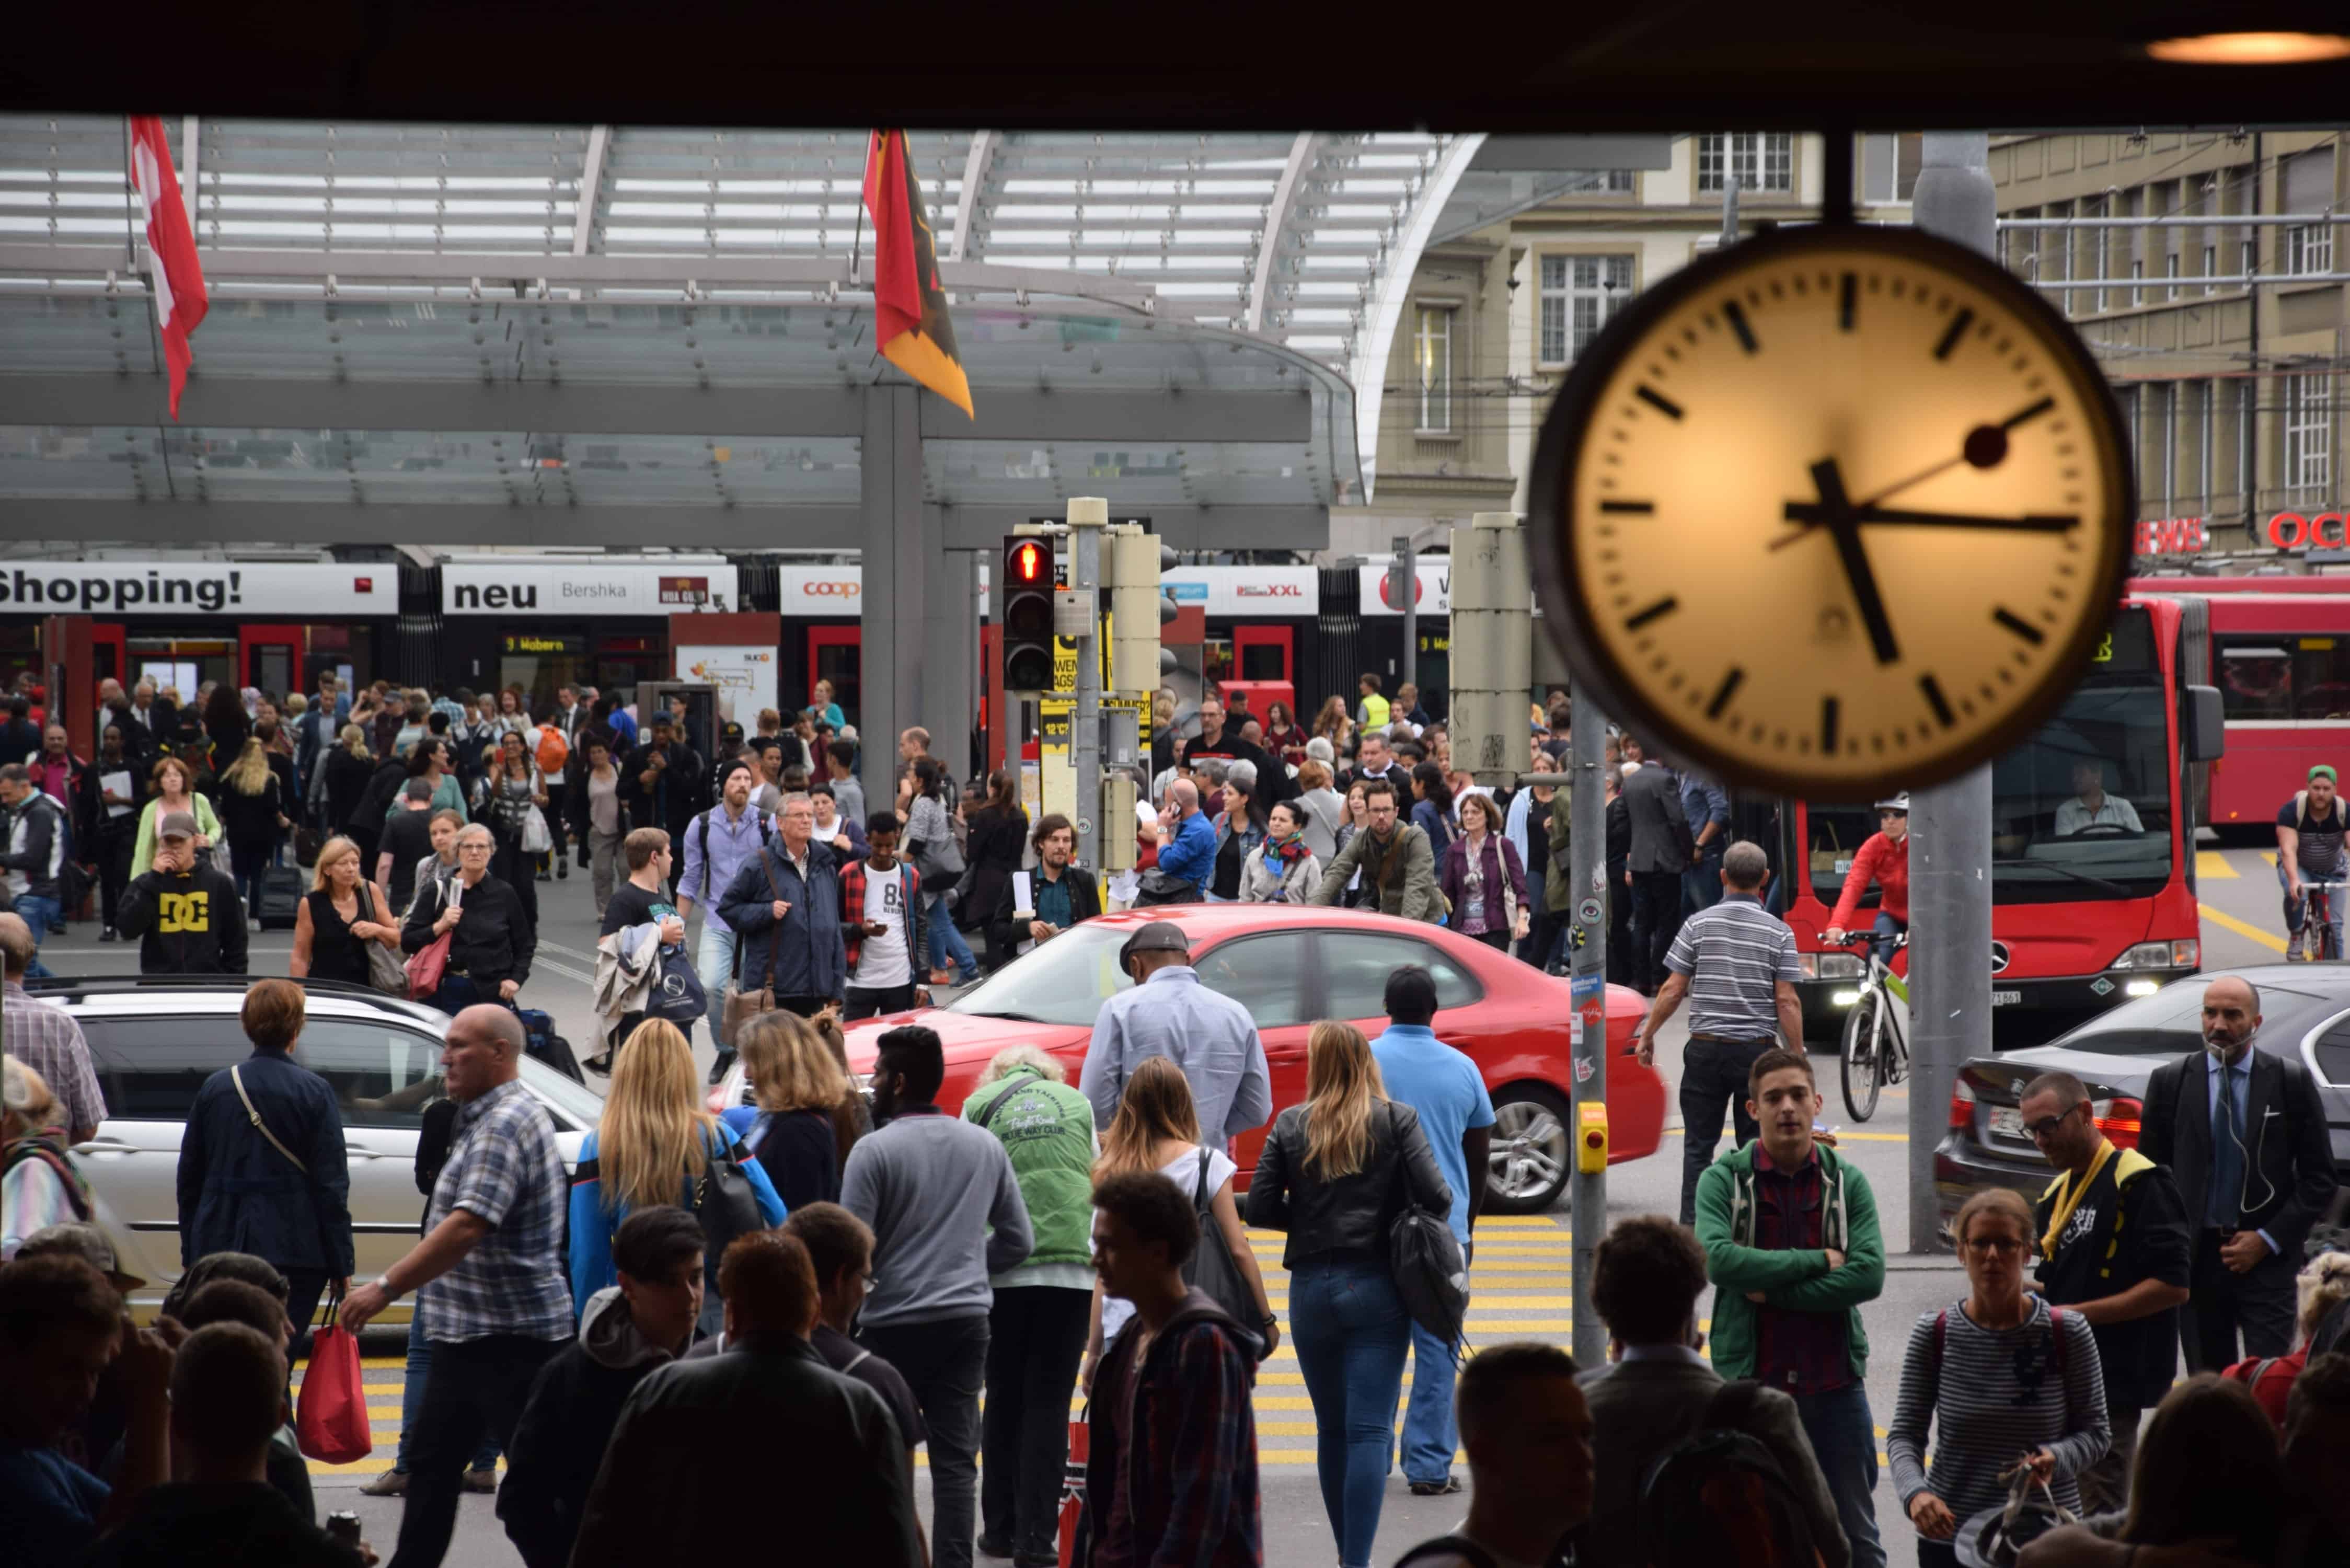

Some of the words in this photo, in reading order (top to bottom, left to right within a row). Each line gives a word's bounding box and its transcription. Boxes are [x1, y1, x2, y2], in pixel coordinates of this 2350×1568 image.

[2268, 512, 2350, 548] OC
[454, 583, 537, 608] neu
[562, 582, 627, 598] Bershka
[803, 582, 861, 599] coop
[1267, 585, 1302, 596] XXL
[159, 891, 209, 933] DC
